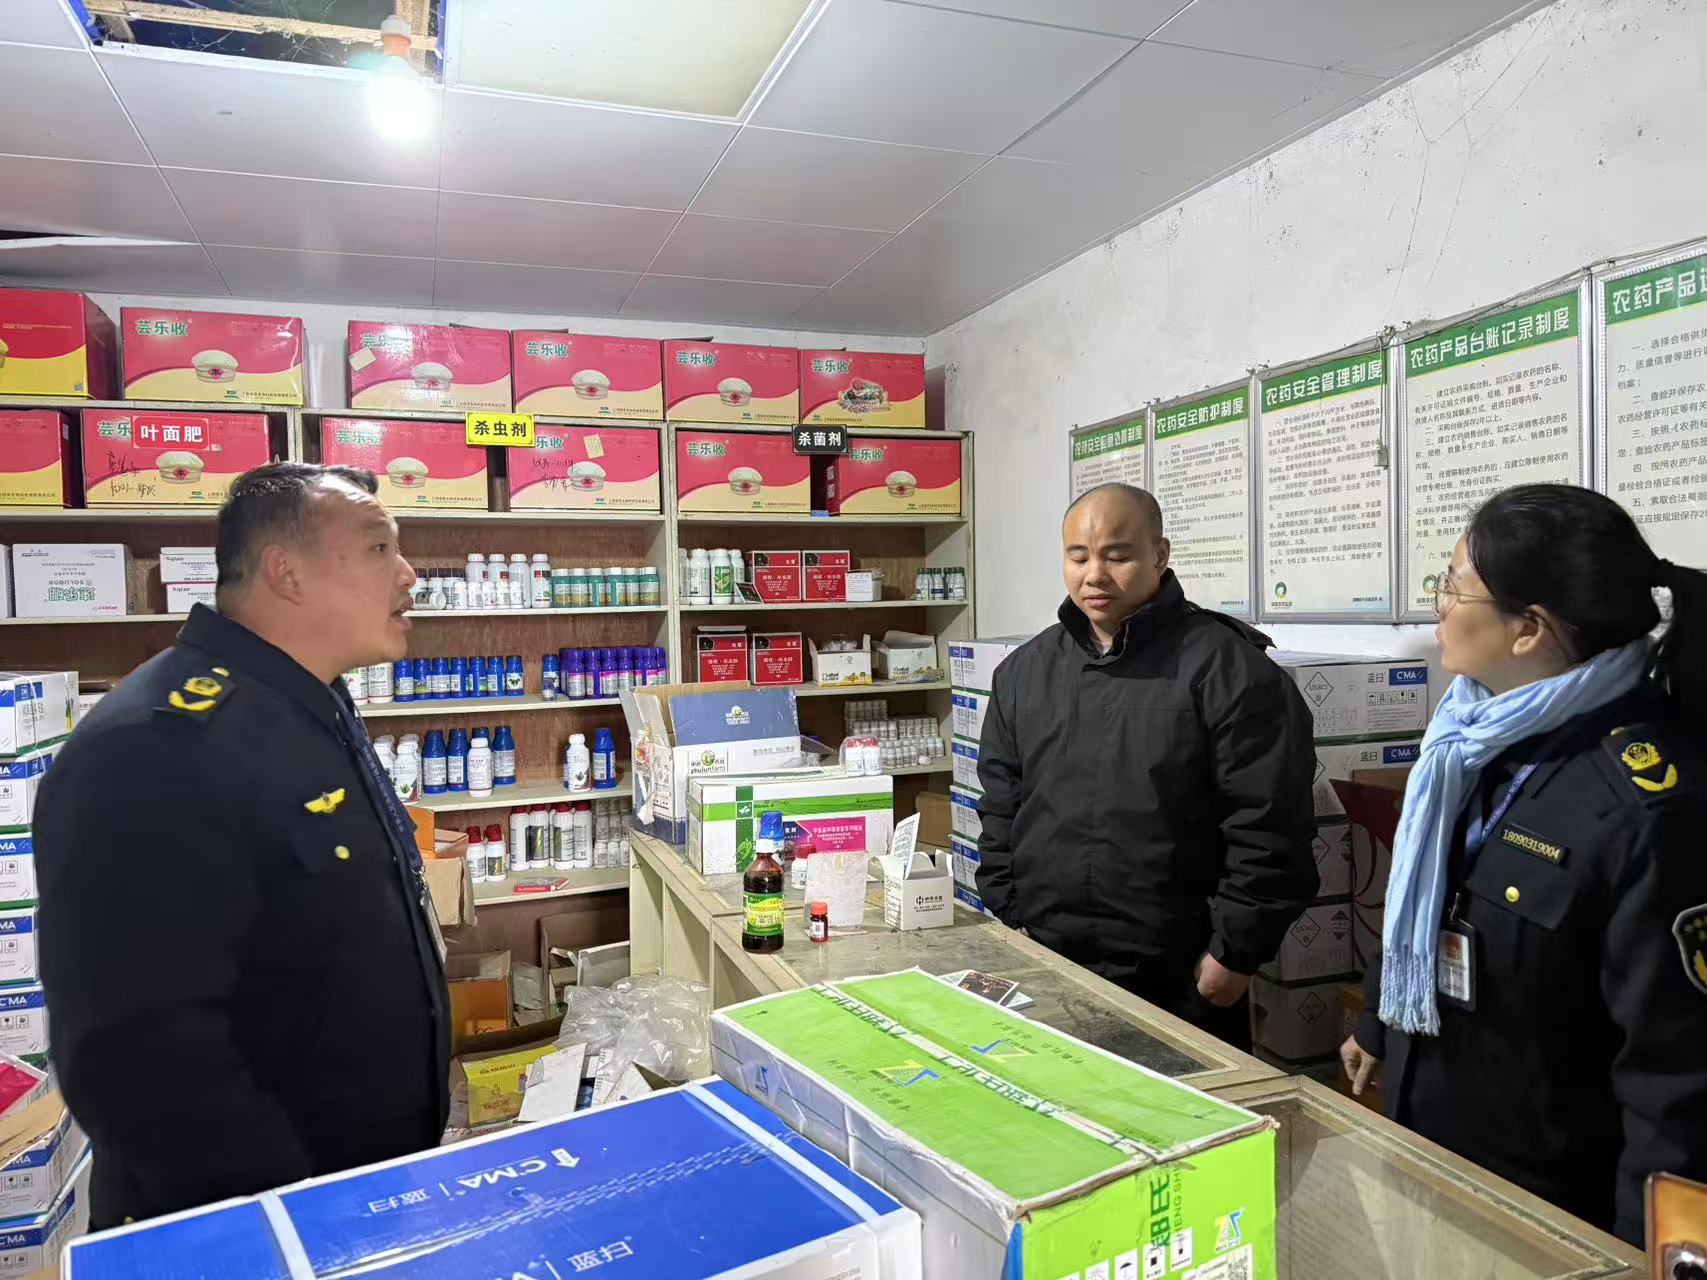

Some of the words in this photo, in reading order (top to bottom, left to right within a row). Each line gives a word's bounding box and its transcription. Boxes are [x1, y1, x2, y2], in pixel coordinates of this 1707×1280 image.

[135, 320, 188, 337] 芸乐收
[1410, 306, 1570, 368] 农药产品台账记录制度
[526, 342, 569, 359] 芸乐收
[677, 351, 715, 366] 芸乐收
[812, 359, 849, 374] 芸乐收
[1265, 359, 1383, 406] 农药安全管理制度
[1157, 397, 1244, 434] 农药安全防护制度
[140, 424, 204, 443] 叶面肥
[474, 420, 527, 438] 杀虫剂
[798, 429, 842, 447] 杀菌剂
[687, 441, 726, 456] 芸乐收
[848, 448, 885, 462] 芸乐收
[1502, 828, 1561, 860] 18090319004
